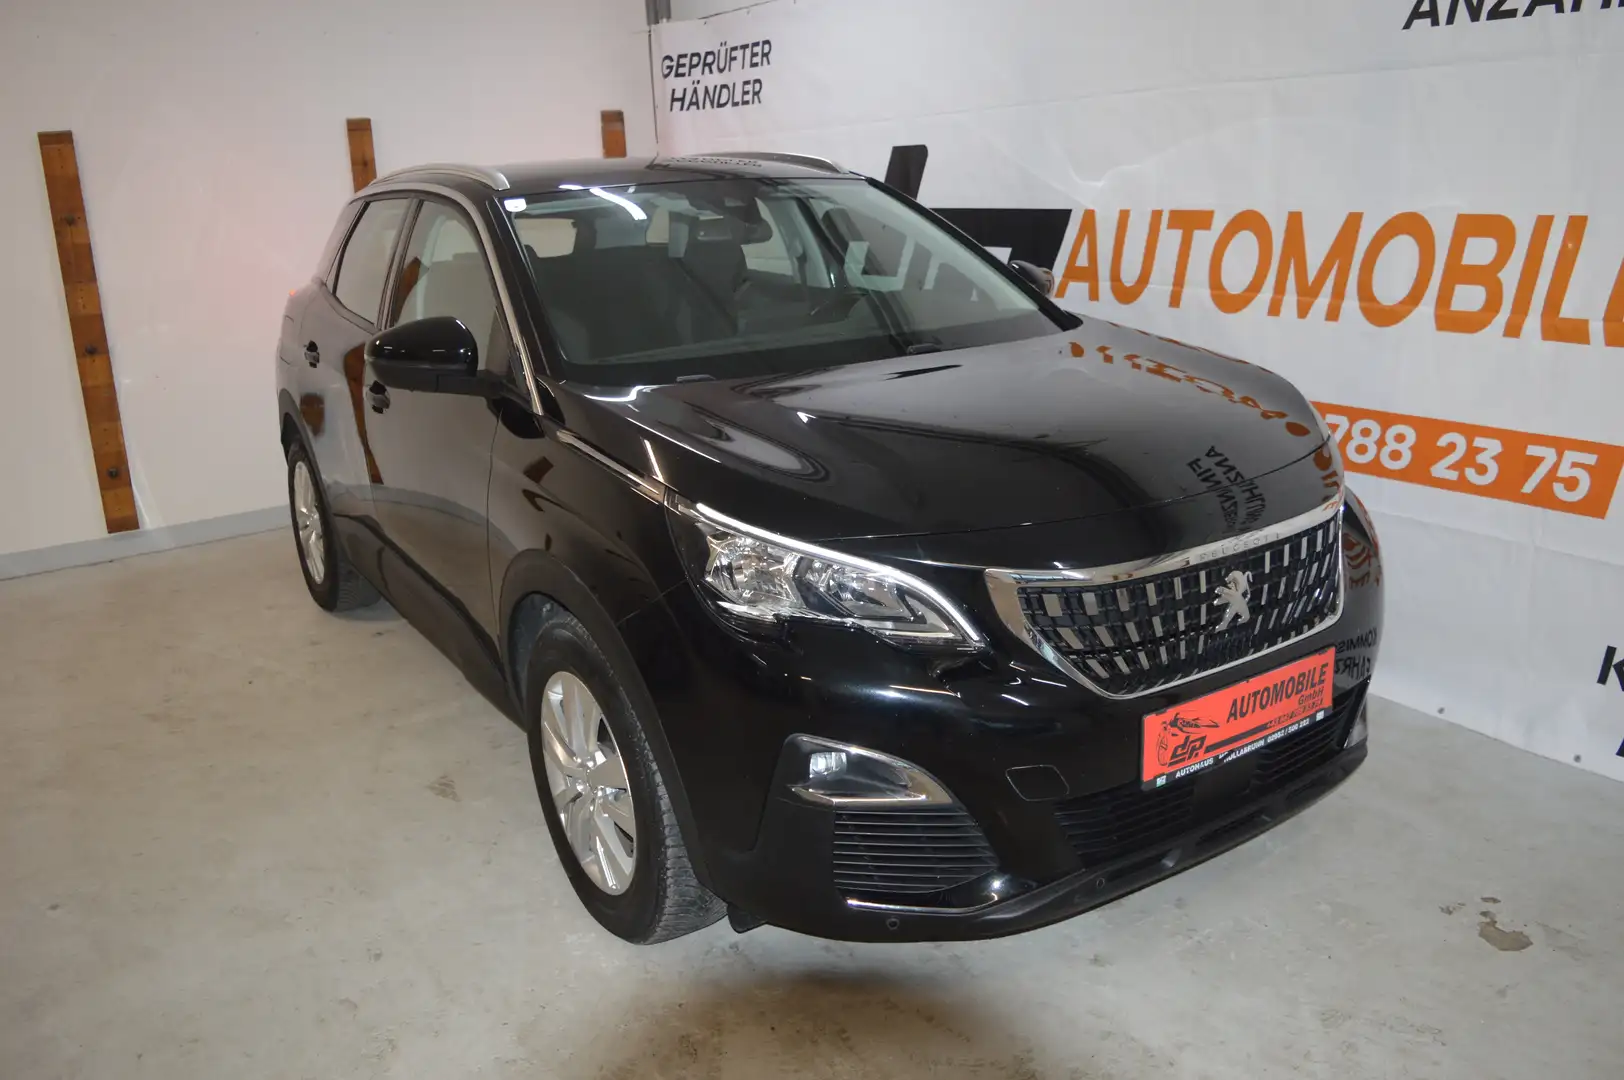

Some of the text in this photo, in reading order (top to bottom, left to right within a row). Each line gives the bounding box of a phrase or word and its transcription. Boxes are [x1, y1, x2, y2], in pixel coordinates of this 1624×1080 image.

[661, 40, 772, 80] GEPRÜFTER
[670, 79, 763, 111] HÄNDLER
[1325, 413, 1598, 502] 788 23 75
[1226, 663, 1329, 723] AUTOMOBILE
[1298, 686, 1324, 705] GmbH
